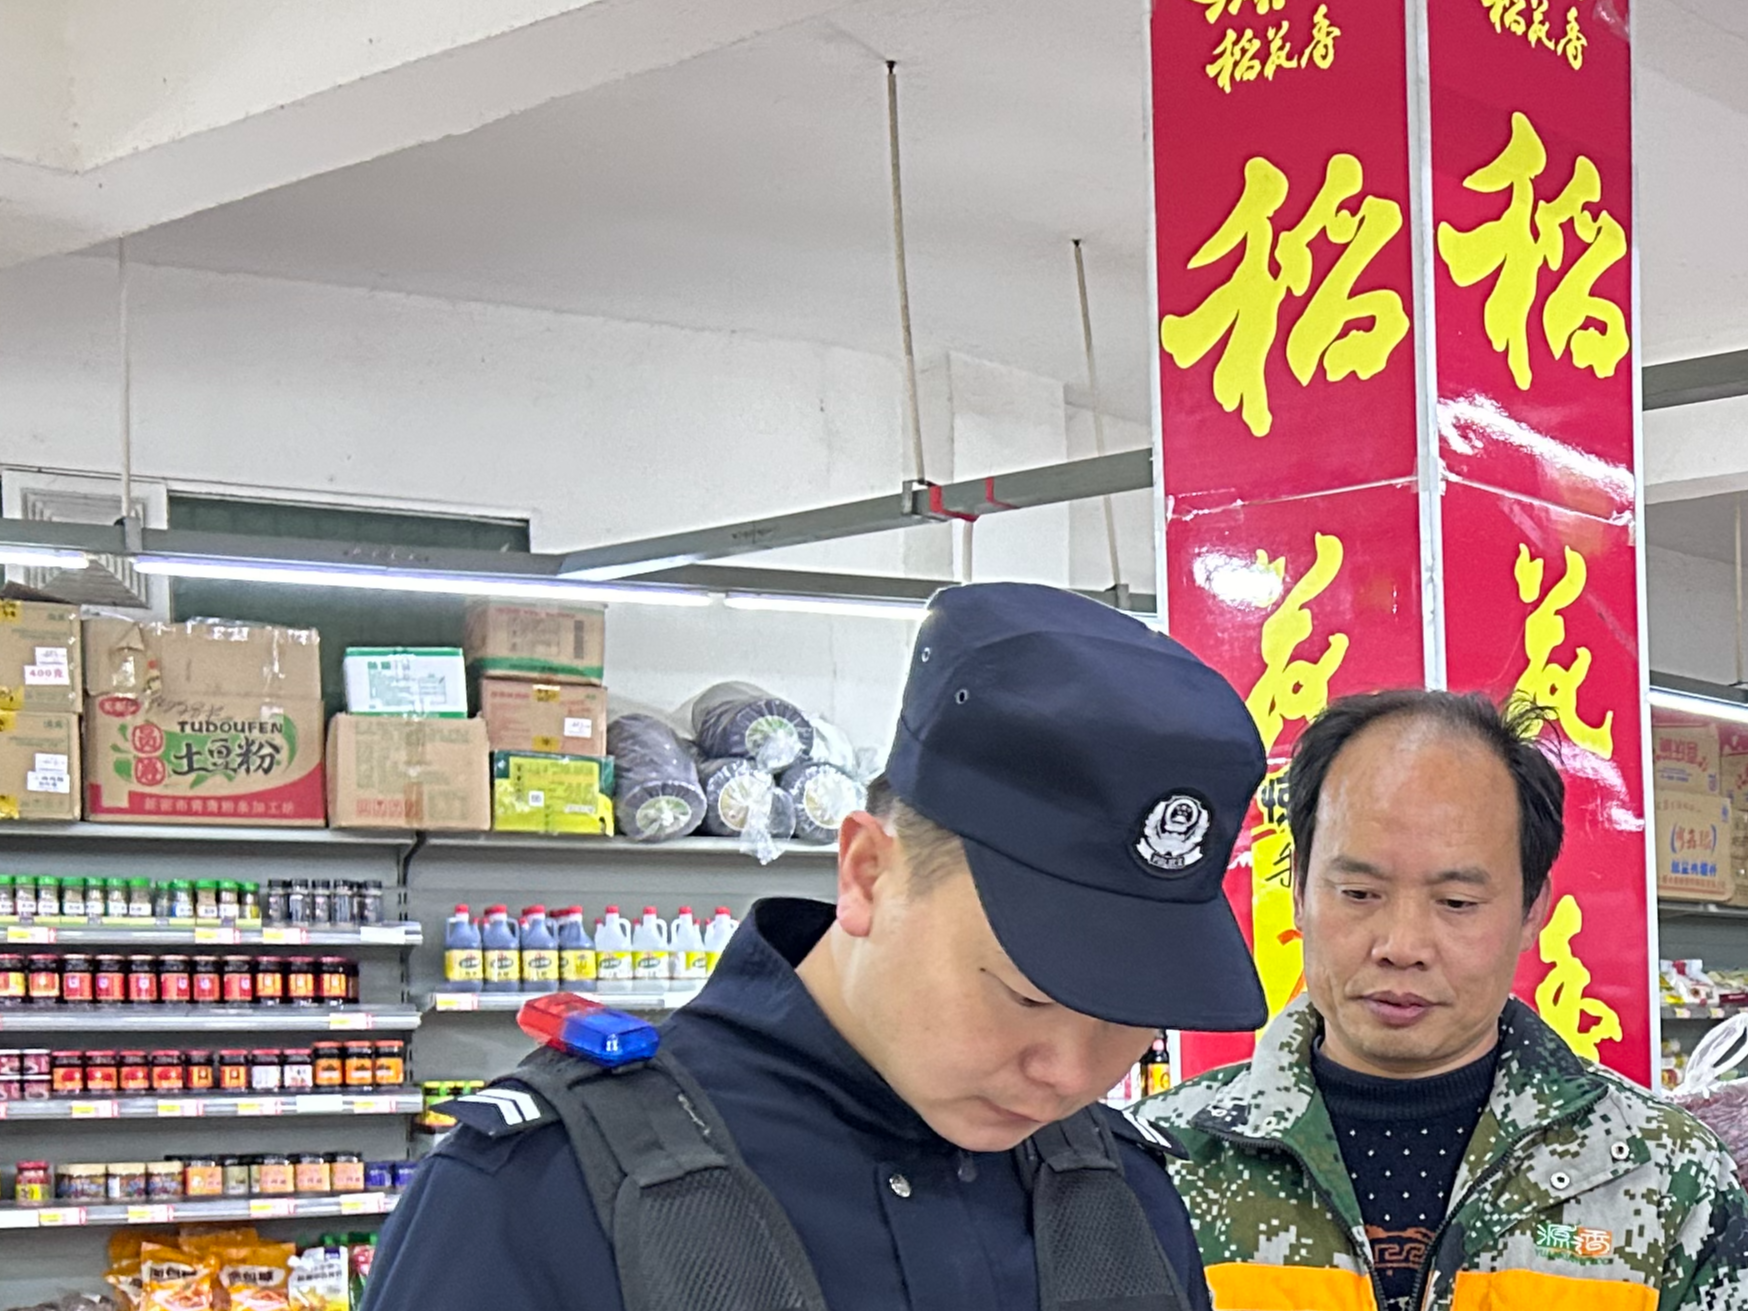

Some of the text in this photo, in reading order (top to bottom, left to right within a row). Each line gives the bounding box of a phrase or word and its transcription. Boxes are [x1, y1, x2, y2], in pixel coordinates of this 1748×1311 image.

[1206, 4, 1341, 94] 稻花香
[177, 721, 283, 734] TUDOUFEN
[172, 736, 281, 776] 土豆粉
